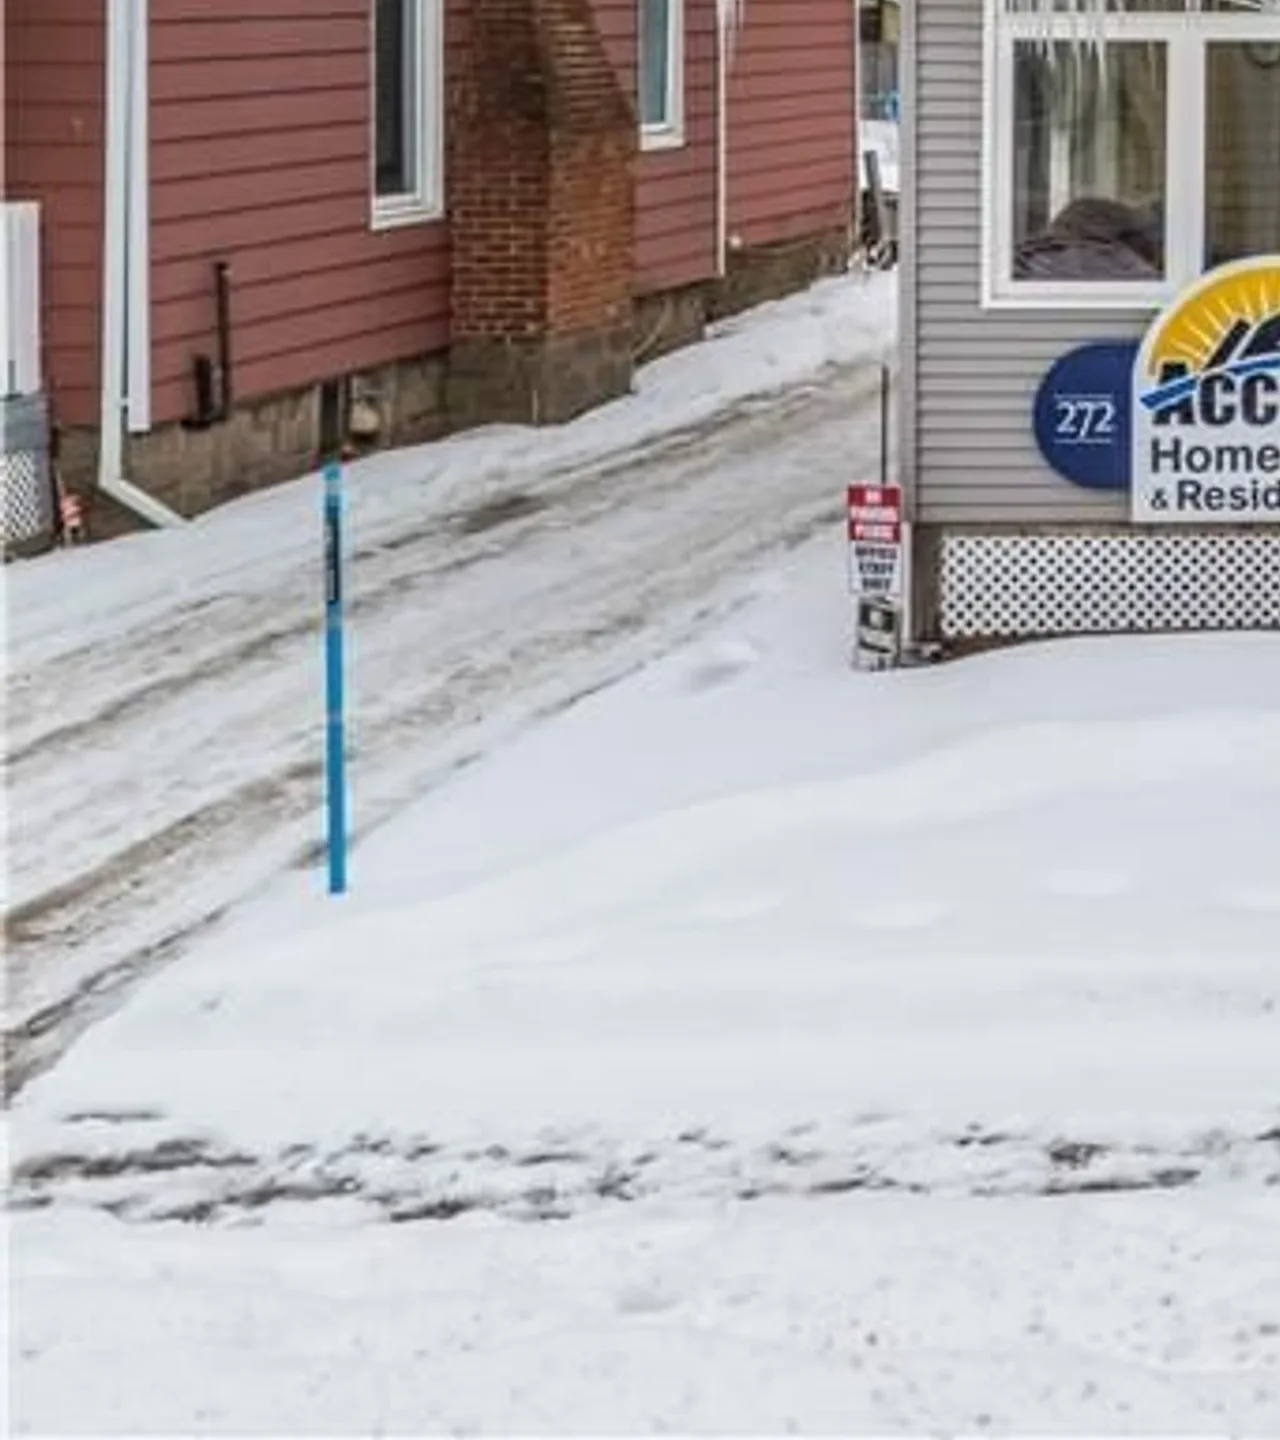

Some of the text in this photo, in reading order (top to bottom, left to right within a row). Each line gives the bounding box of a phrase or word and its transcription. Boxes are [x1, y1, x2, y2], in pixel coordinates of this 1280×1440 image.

[1055, 402, 1114, 440] 272
[1150, 437, 1280, 474] Home
[1151, 490, 1169, 511] &
